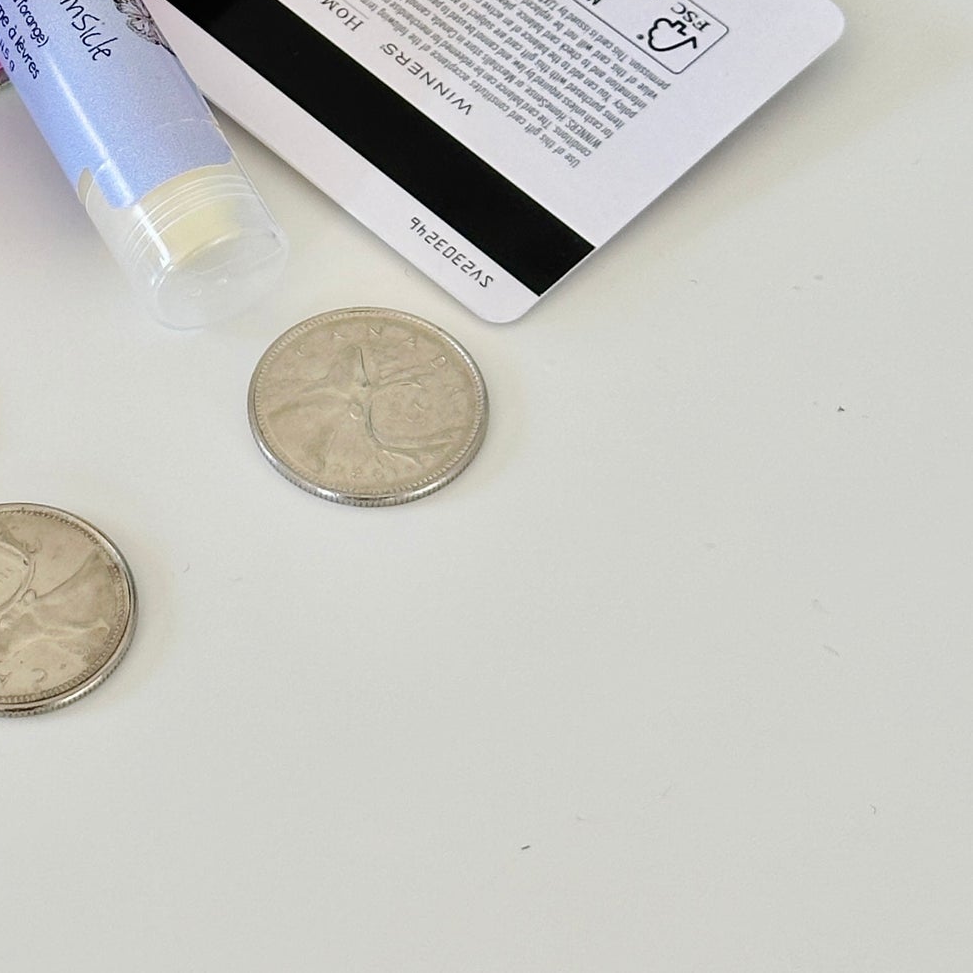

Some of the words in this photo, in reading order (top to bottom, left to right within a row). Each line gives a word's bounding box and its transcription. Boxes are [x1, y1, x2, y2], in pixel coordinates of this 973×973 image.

[669, 1, 711, 32] FSC
[13, 34, 40, 80] lèvres
[381, 42, 473, 116] WINNERS
